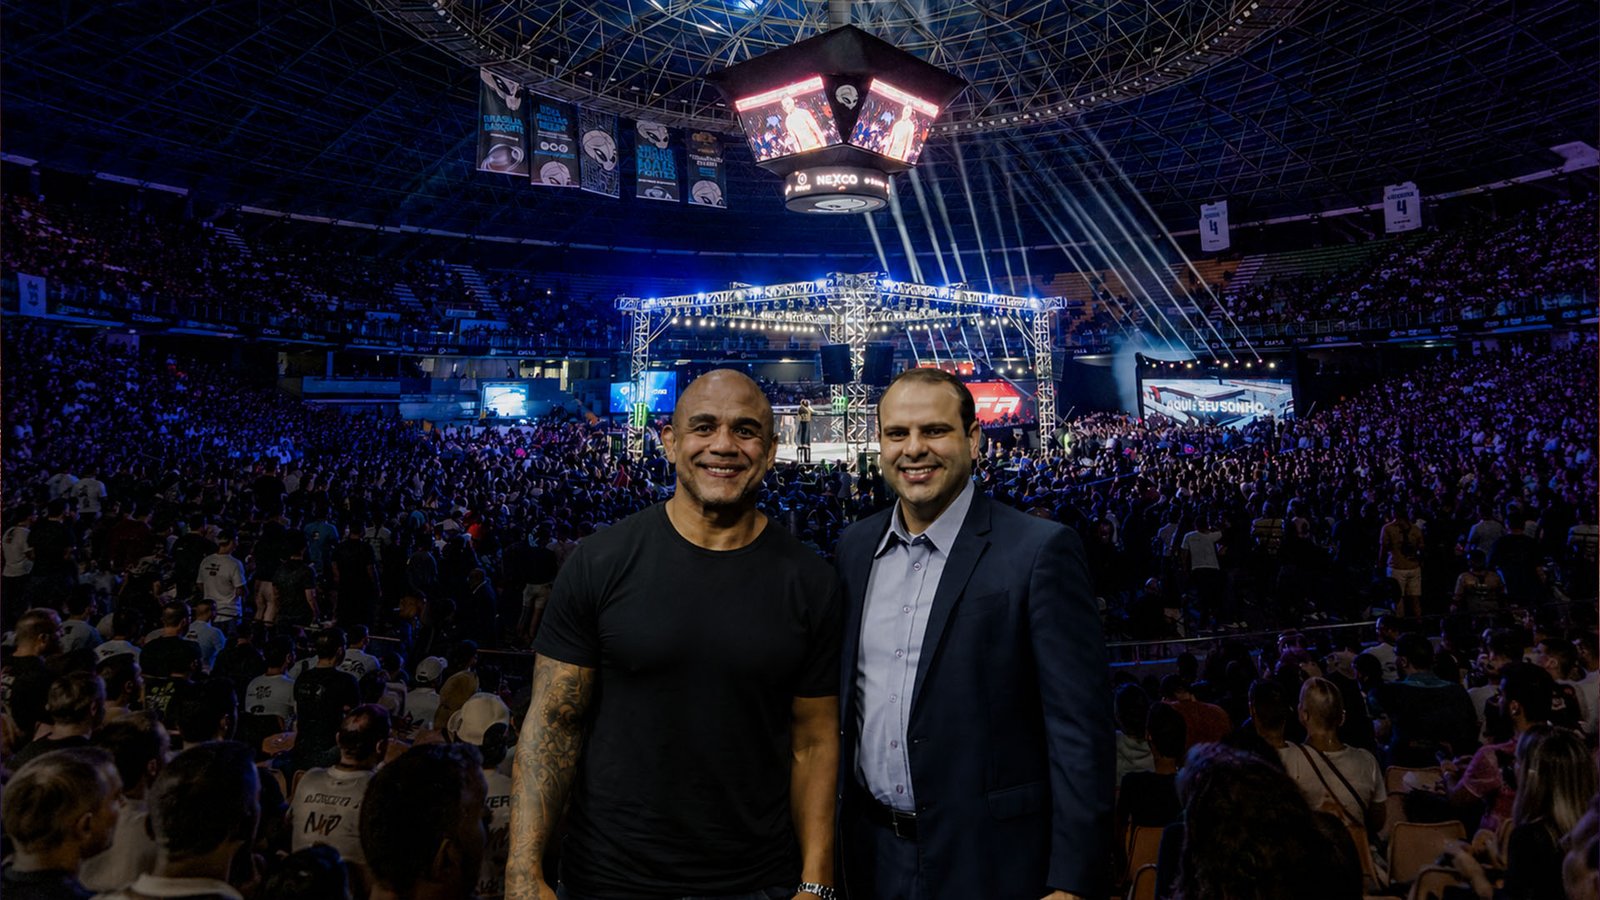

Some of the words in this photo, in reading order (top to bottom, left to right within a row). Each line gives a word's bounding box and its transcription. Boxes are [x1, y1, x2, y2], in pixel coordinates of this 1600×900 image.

[815, 173, 858, 185] NEXCO
[1397, 199, 1407, 215] 4
[1209, 219, 1218, 235] 4
[1166, 399, 1191, 411] AQUI
[1198, 399, 1218, 412] SEU
[1219, 400, 1264, 414] SONHO
